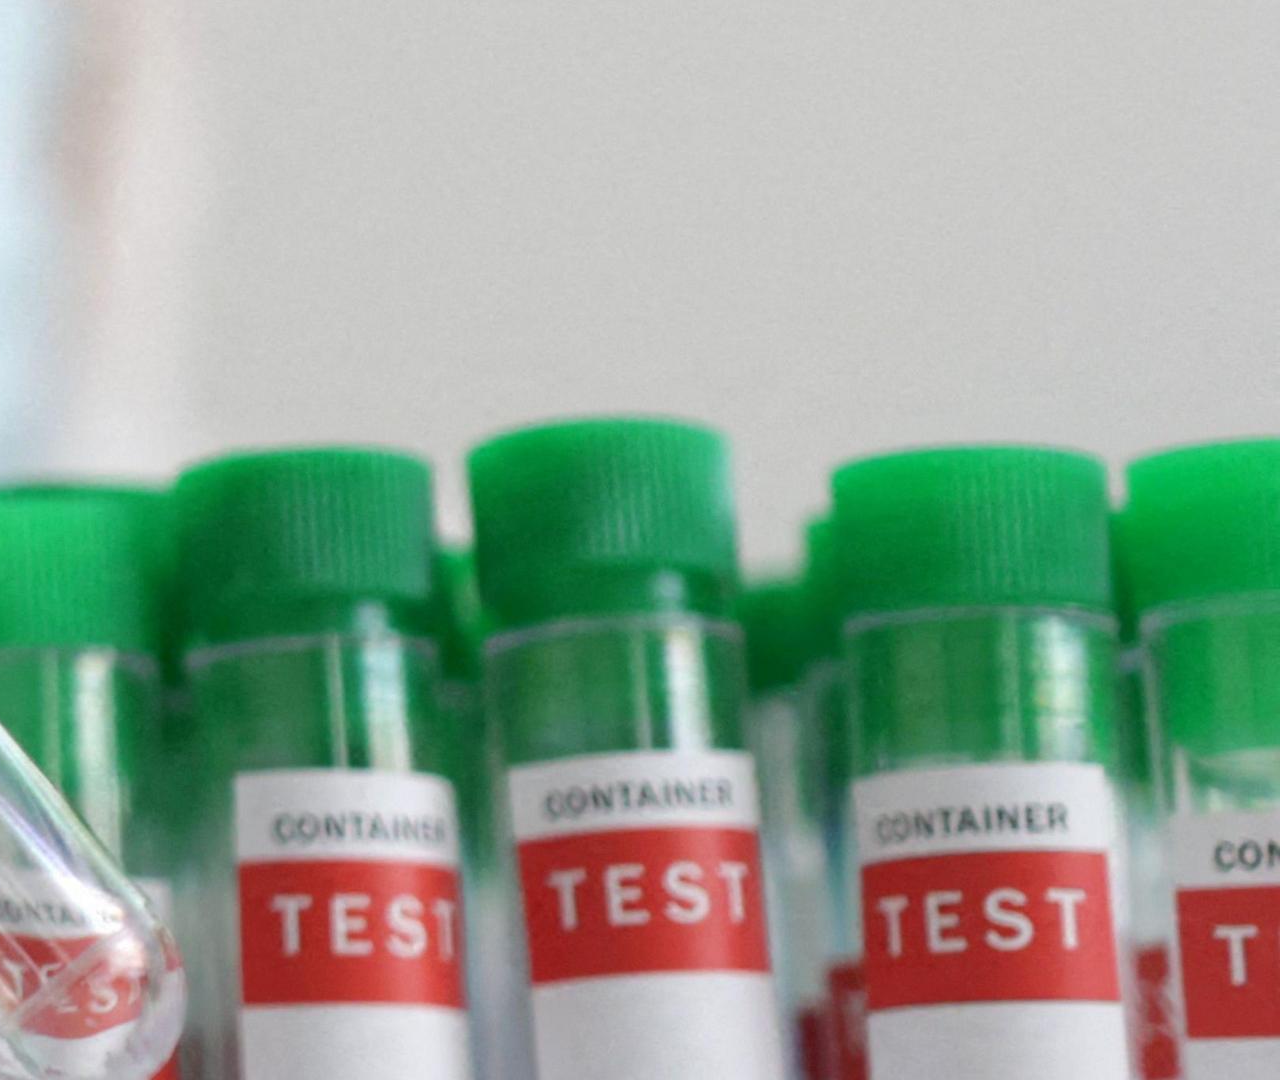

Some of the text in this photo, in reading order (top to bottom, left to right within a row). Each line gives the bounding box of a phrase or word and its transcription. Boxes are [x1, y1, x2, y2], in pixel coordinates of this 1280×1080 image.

[545, 778, 734, 820] CONTAINER
[876, 803, 1069, 844] CONTAINER
[270, 893, 455, 961] TEST
[547, 861, 748, 930] TEST
[877, 888, 1086, 958] TEST
